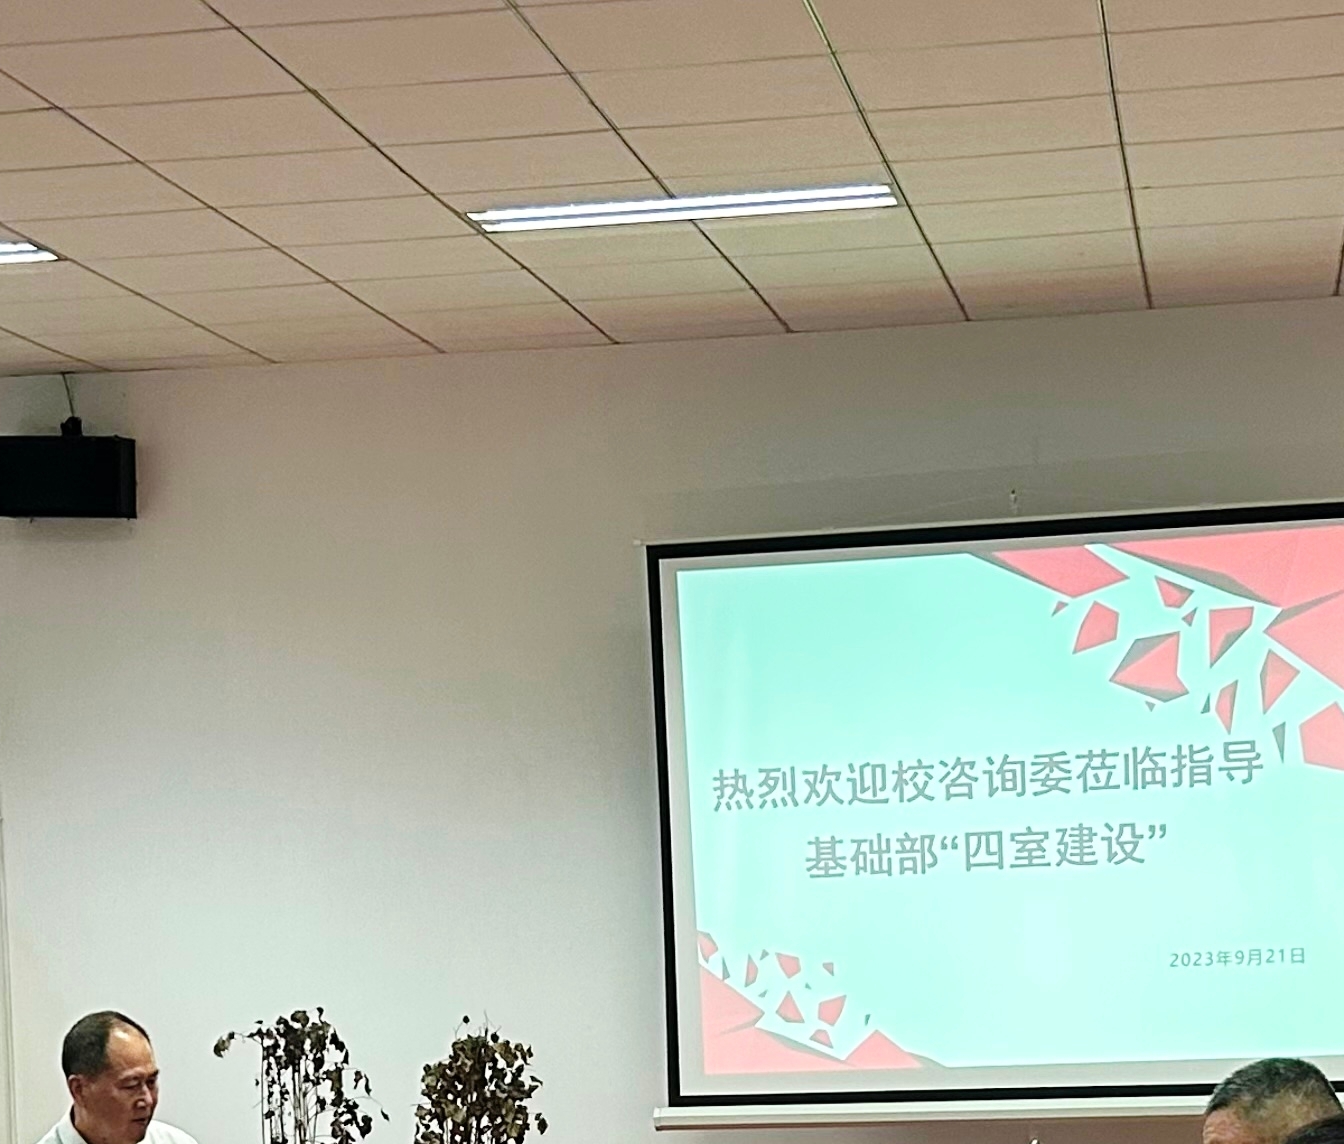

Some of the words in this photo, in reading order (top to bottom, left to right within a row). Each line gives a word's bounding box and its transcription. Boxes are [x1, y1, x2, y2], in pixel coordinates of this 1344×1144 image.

[712, 739, 1265, 813] 热烈欢迎校咨询委莅临指导
[804, 822, 1168, 879] 基础部“四室建设”
[1168, 946, 1307, 969] 2023年9月21日
